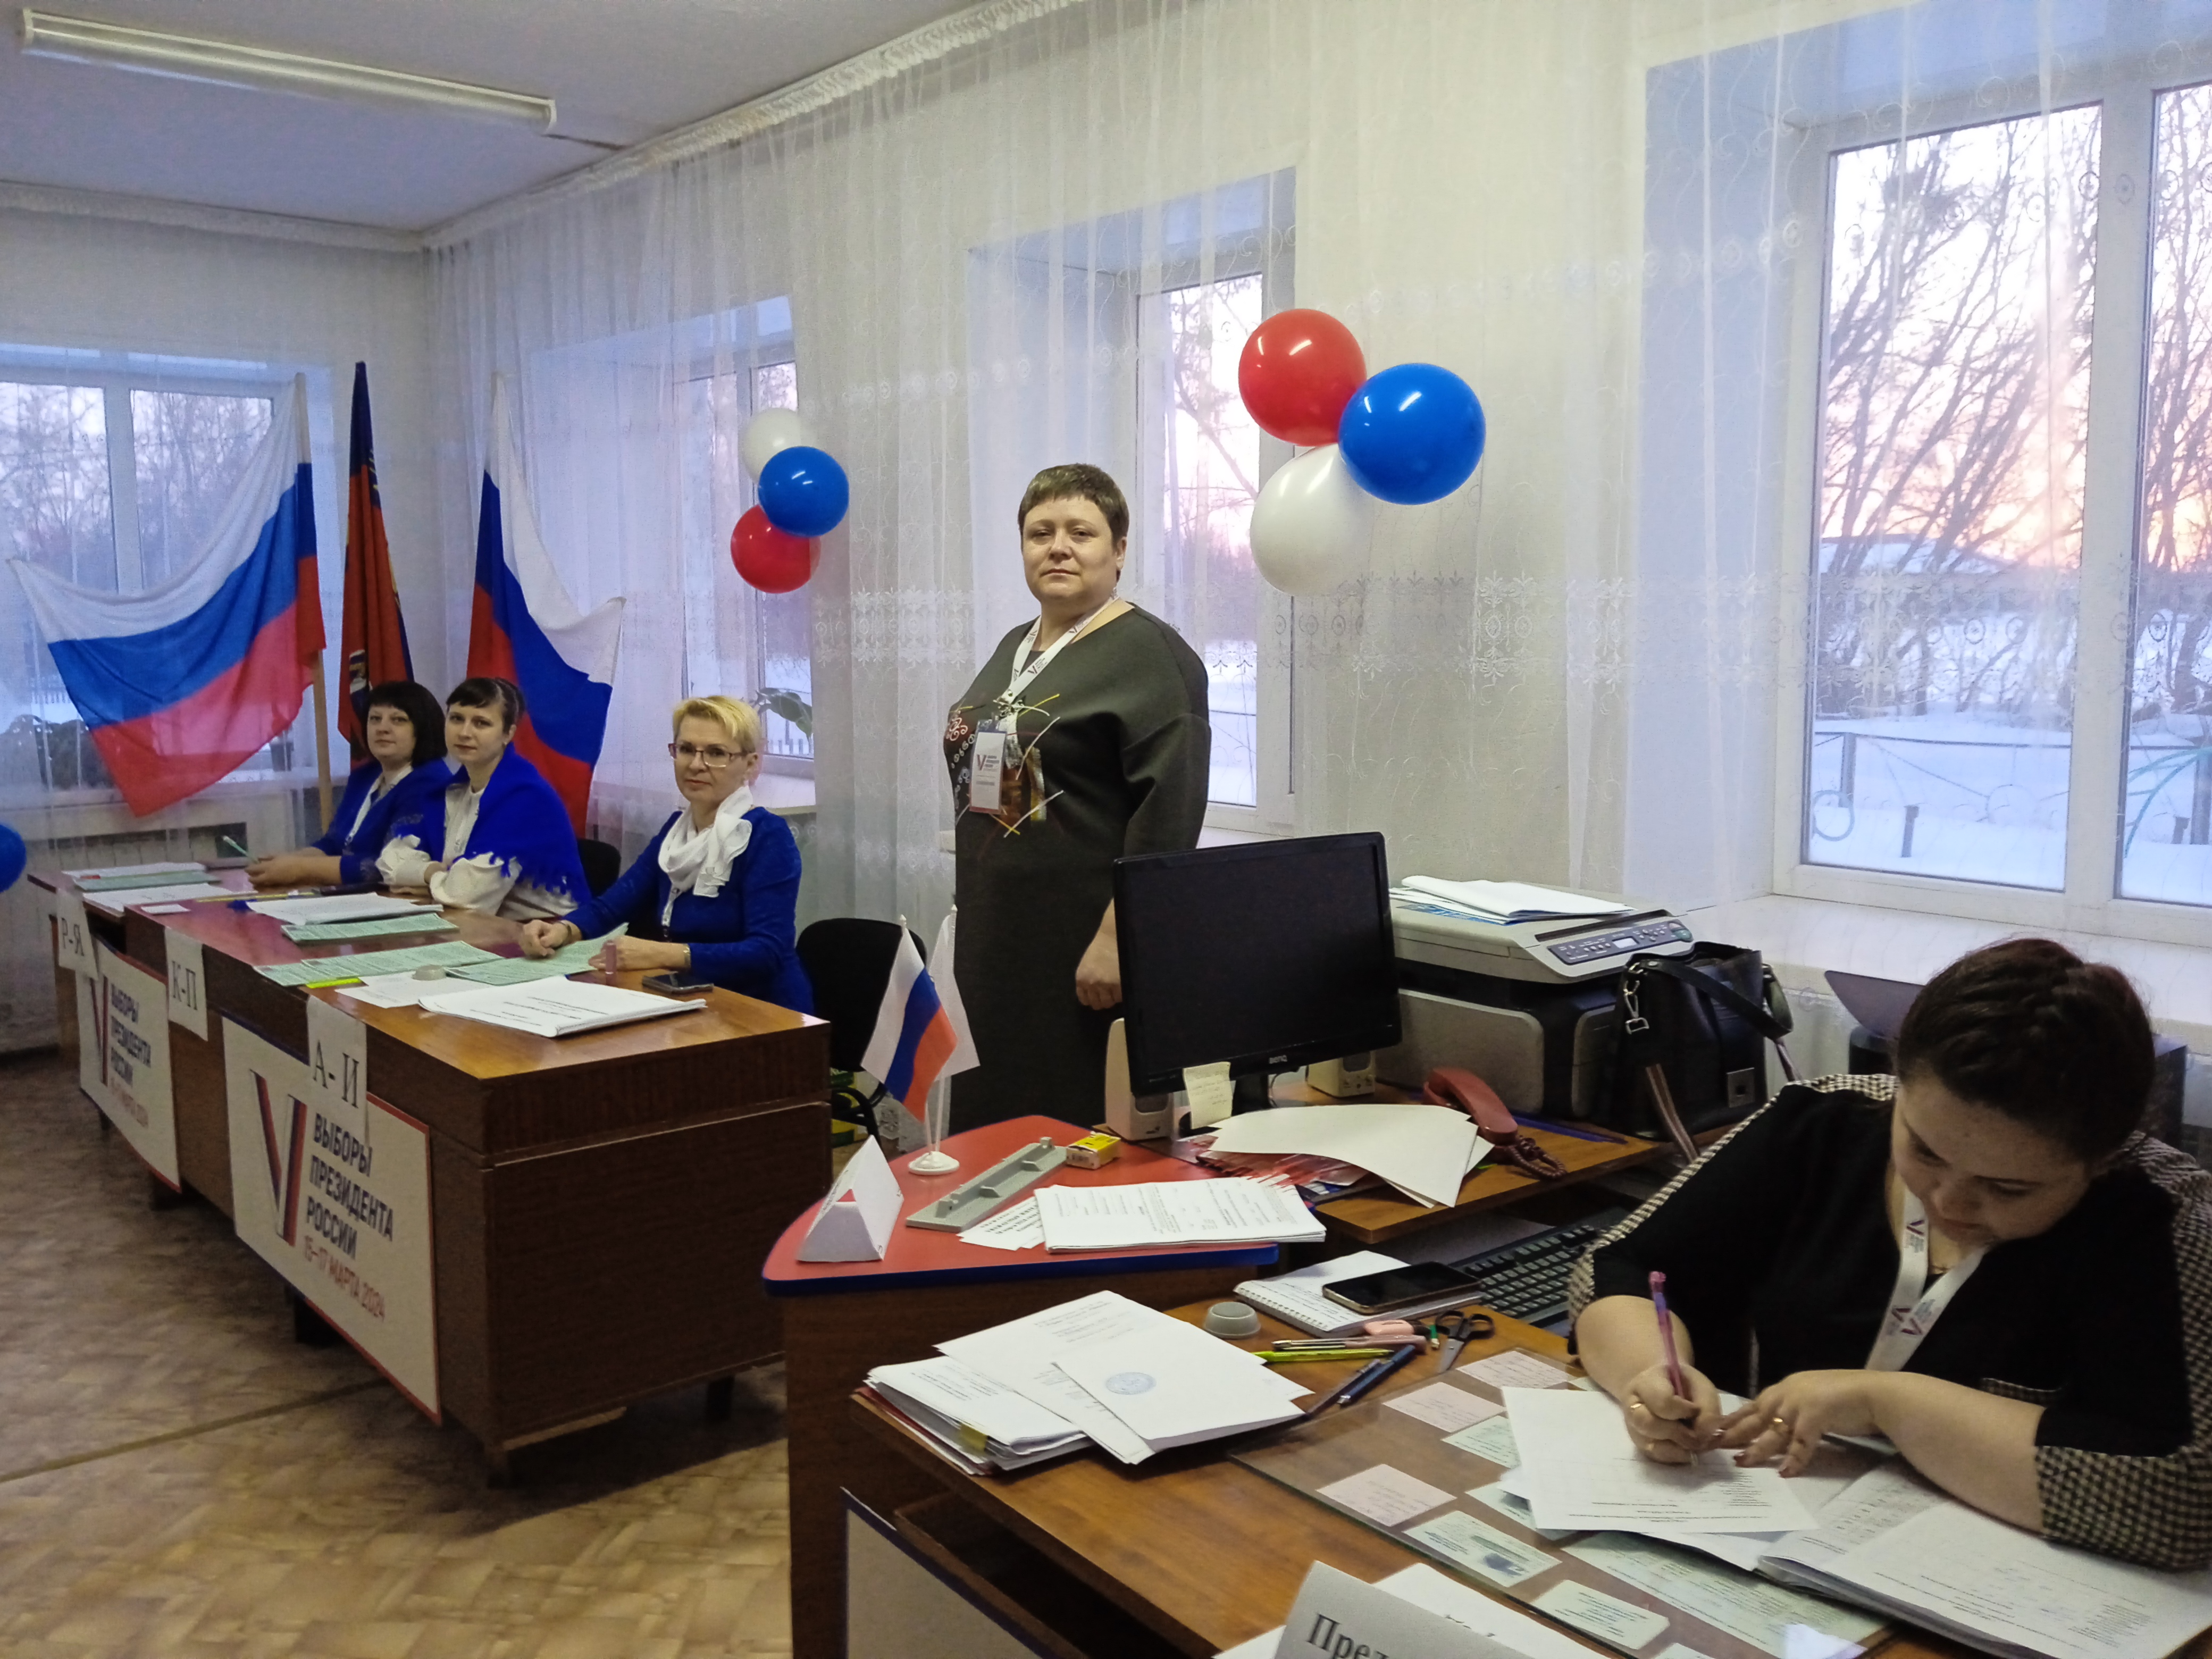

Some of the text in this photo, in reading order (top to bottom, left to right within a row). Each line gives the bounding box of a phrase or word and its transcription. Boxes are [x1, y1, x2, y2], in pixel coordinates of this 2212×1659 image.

[172, 960, 198, 1011] К-П
[314, 1113, 373, 1177] ВЫБОРЫ
[306, 1195, 358, 1260] РОССИИ
[309, 1155, 393, 1242] ПРЕЗИДЕНТА
[1305, 1613, 1389, 1659] Пре
